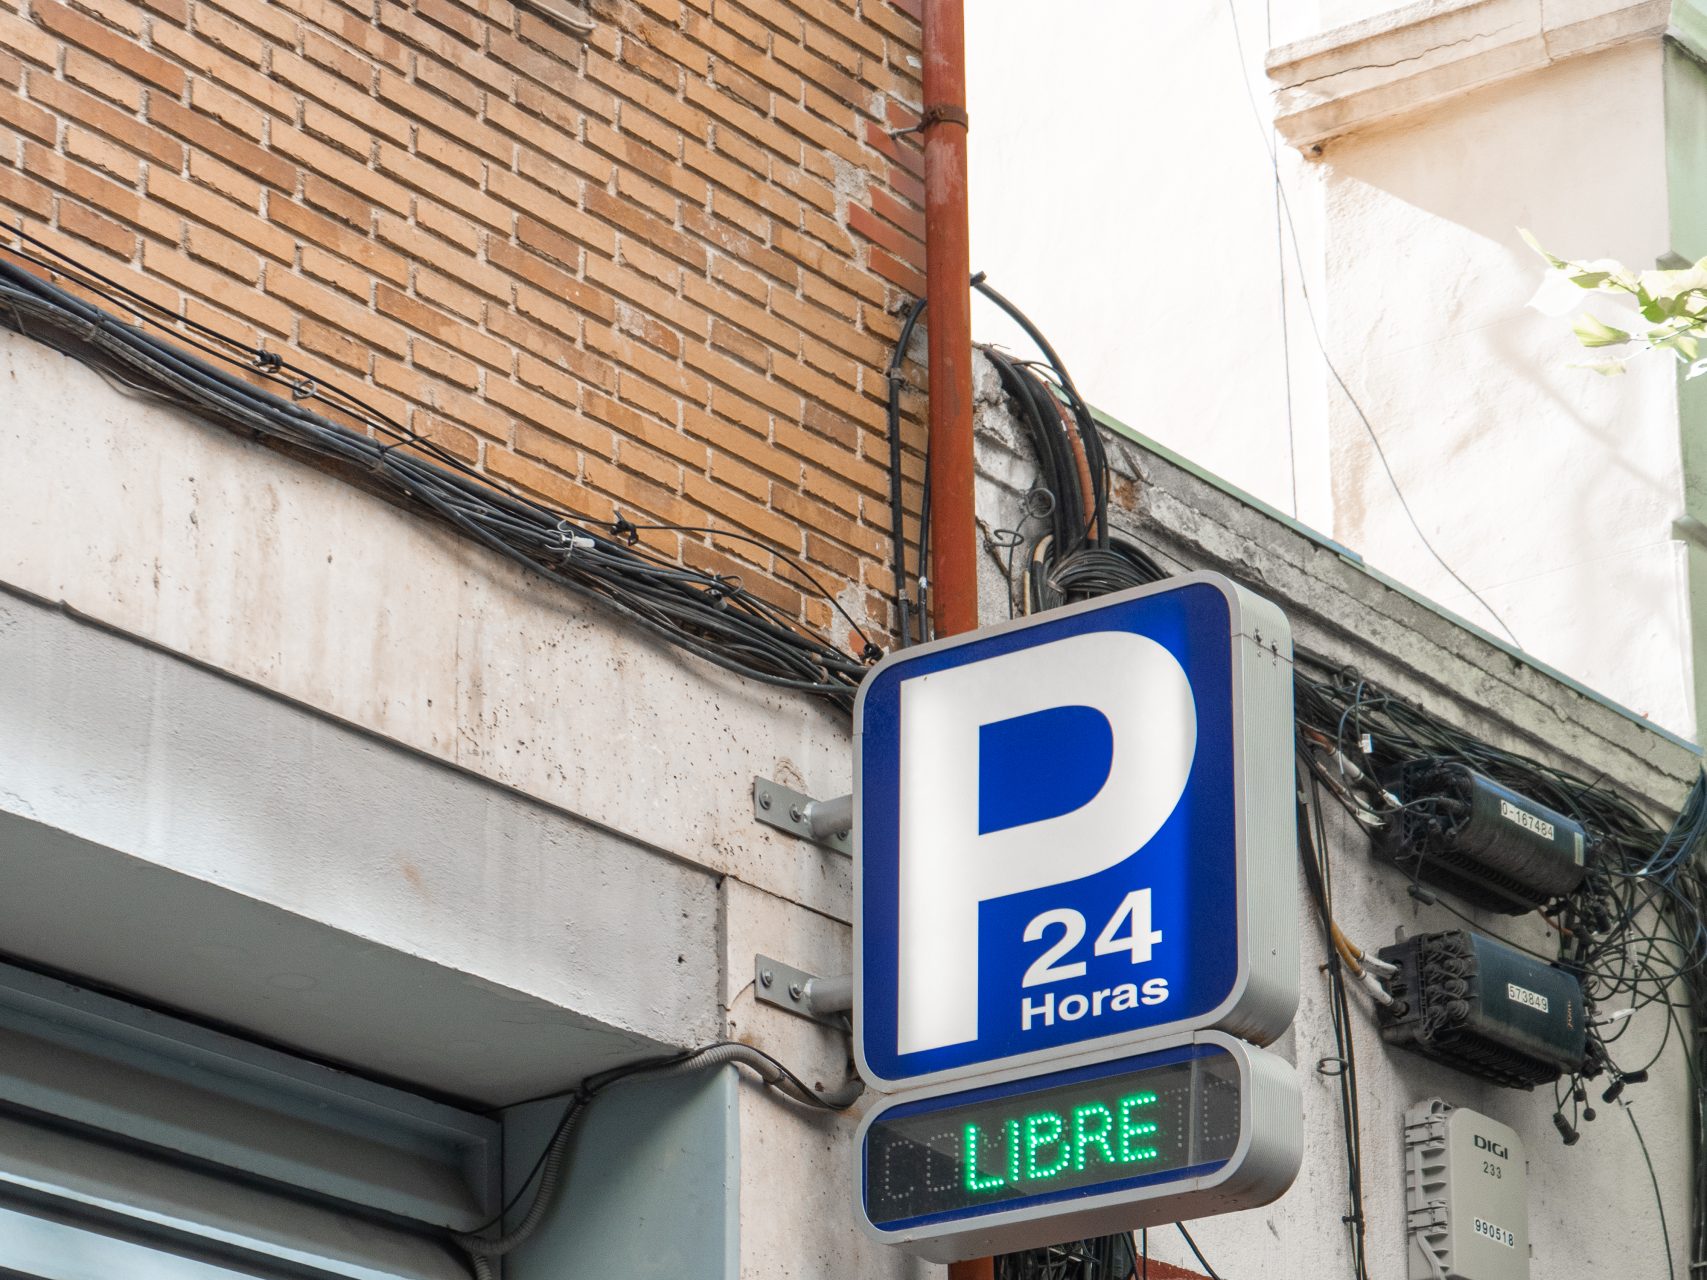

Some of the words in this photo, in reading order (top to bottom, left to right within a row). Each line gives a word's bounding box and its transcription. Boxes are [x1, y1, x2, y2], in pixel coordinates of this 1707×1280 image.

[897, 630, 1197, 1056] P
[1021, 887, 1163, 988] 24
[1021, 976, 1170, 1032] Horas
[1508, 985, 1548, 1012] 573849
[963, 1091, 1159, 1192] LIBRE
[1474, 1134, 1509, 1160] DIGI
[1483, 1161, 1502, 1179] 233
[1475, 1218, 1514, 1247] 990518
